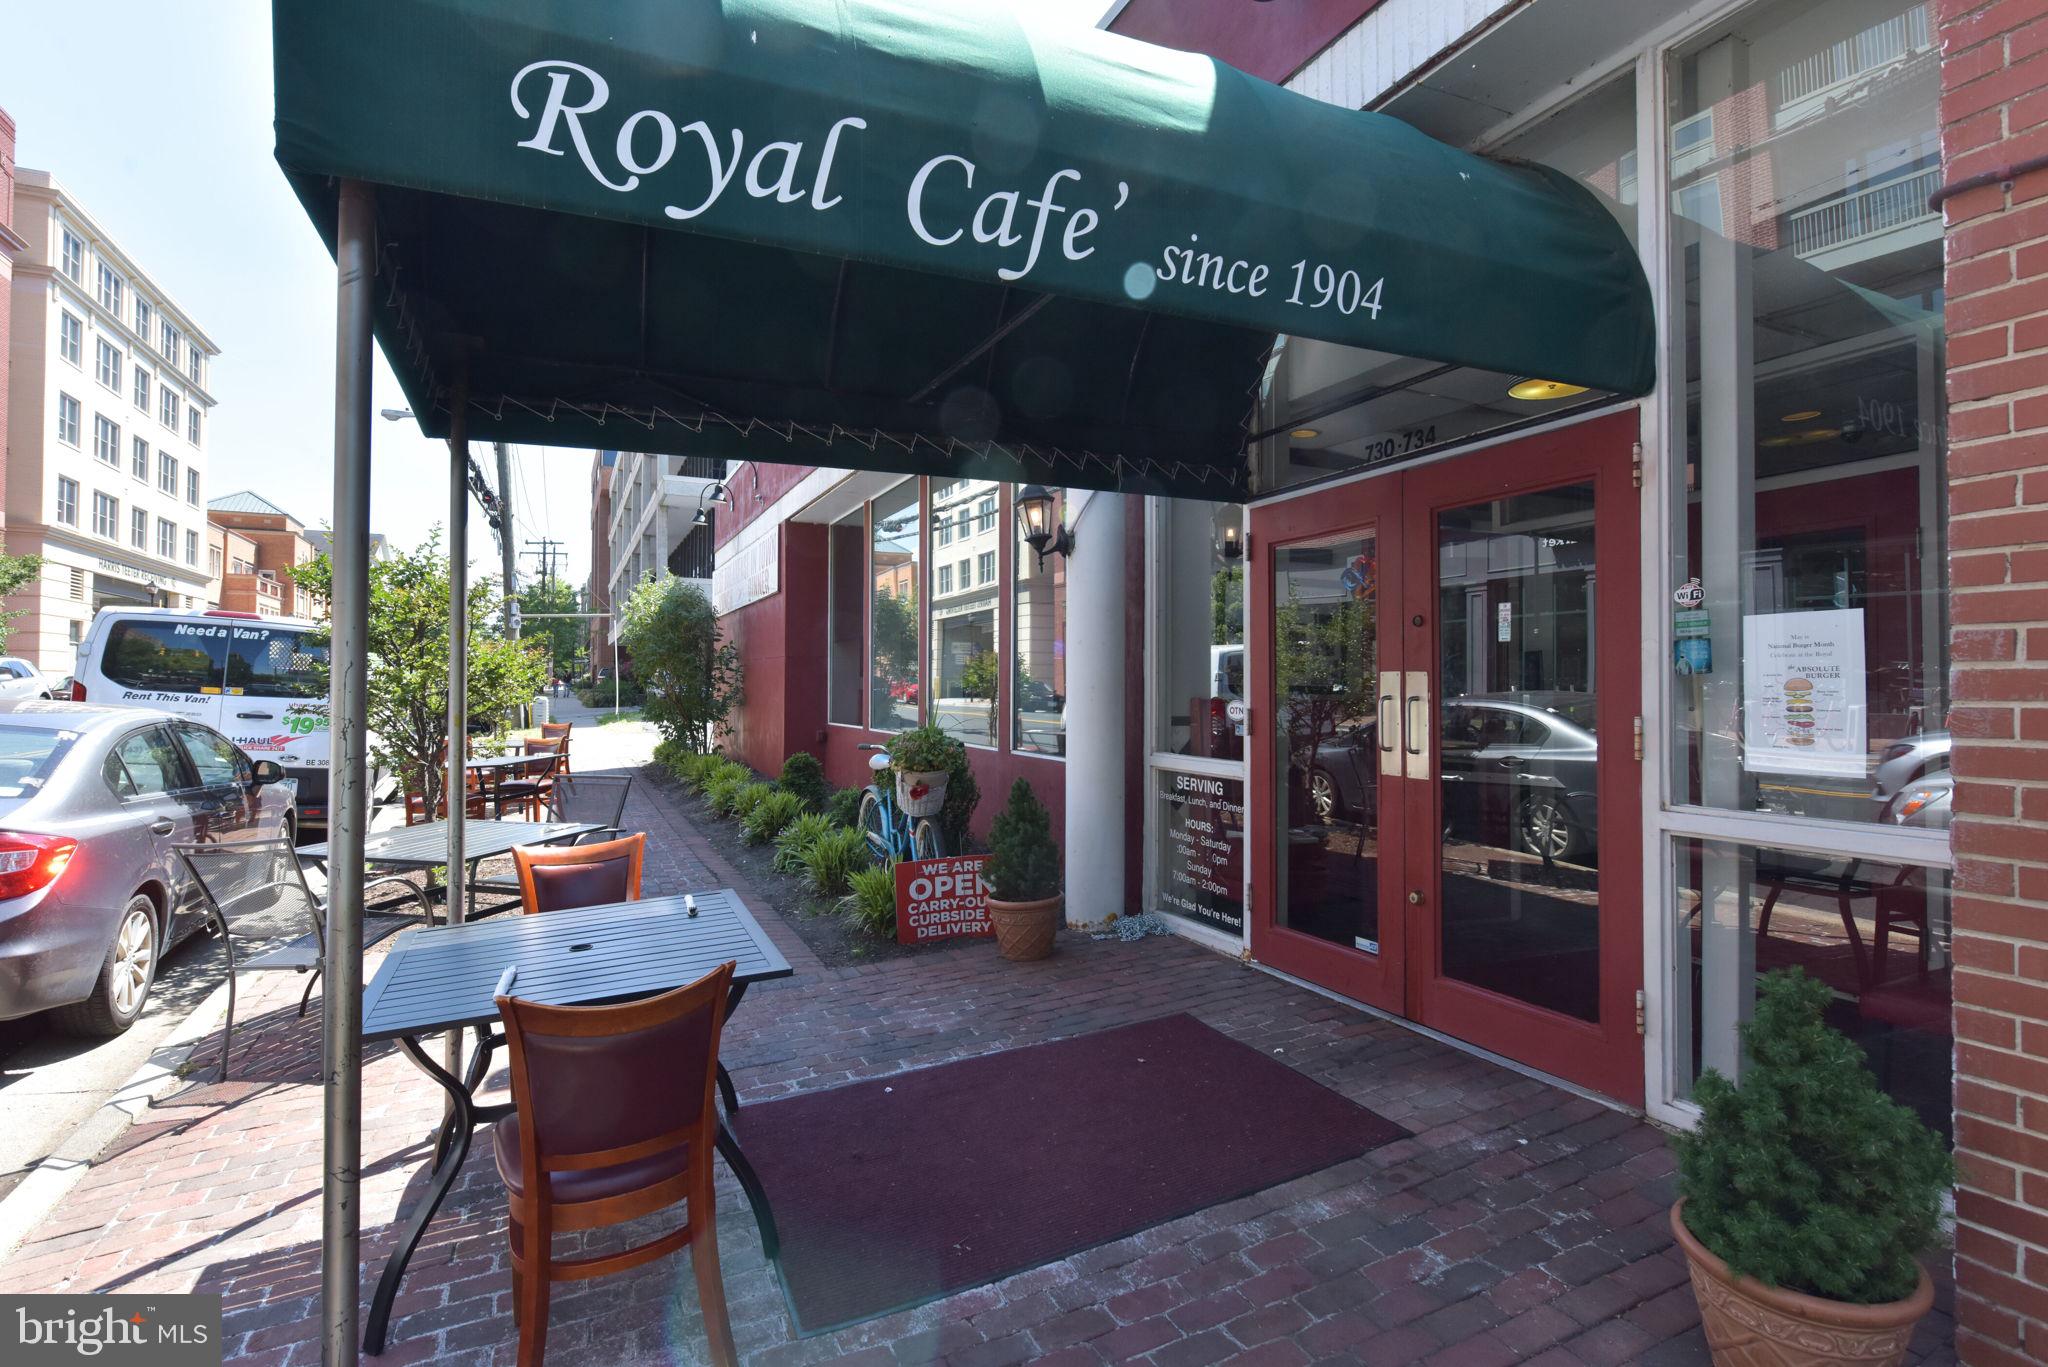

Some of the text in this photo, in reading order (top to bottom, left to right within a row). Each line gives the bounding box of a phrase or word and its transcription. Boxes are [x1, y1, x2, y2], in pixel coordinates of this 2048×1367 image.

[510, 60, 867, 220] Royal
[1156, 233, 1269, 298] since
[1285, 258, 1385, 320] 1904
[174, 624, 270, 641] Need a Van?
[1796, 665, 1841, 673] ABSOLUTE
[122, 691, 212, 704] Rent This Van!
[1176, 776, 1224, 796] SERVING
[1159, 791, 1245, 814] Breakfast, Lunch, and Dinner
[1185, 818, 1214, 834] HOURS:
[1169, 829, 1195, 845] Monday
[1200, 836, 1232, 854] Saturday
[922, 860, 984, 875] WE ARE
[1187, 860, 1212, 877] Sunday
[908, 873, 997, 901] OPEN
[1172, 871, 1197, 886] 7:00am
[1202, 879, 1228, 896] 2:00pm
[907, 896, 988, 915] CARRY-OU
[1162, 892, 1242, 928] We're Glad You're Here!
[908, 908, 985, 927] CURBSIDE
[917, 921, 991, 938] DELIVERY
